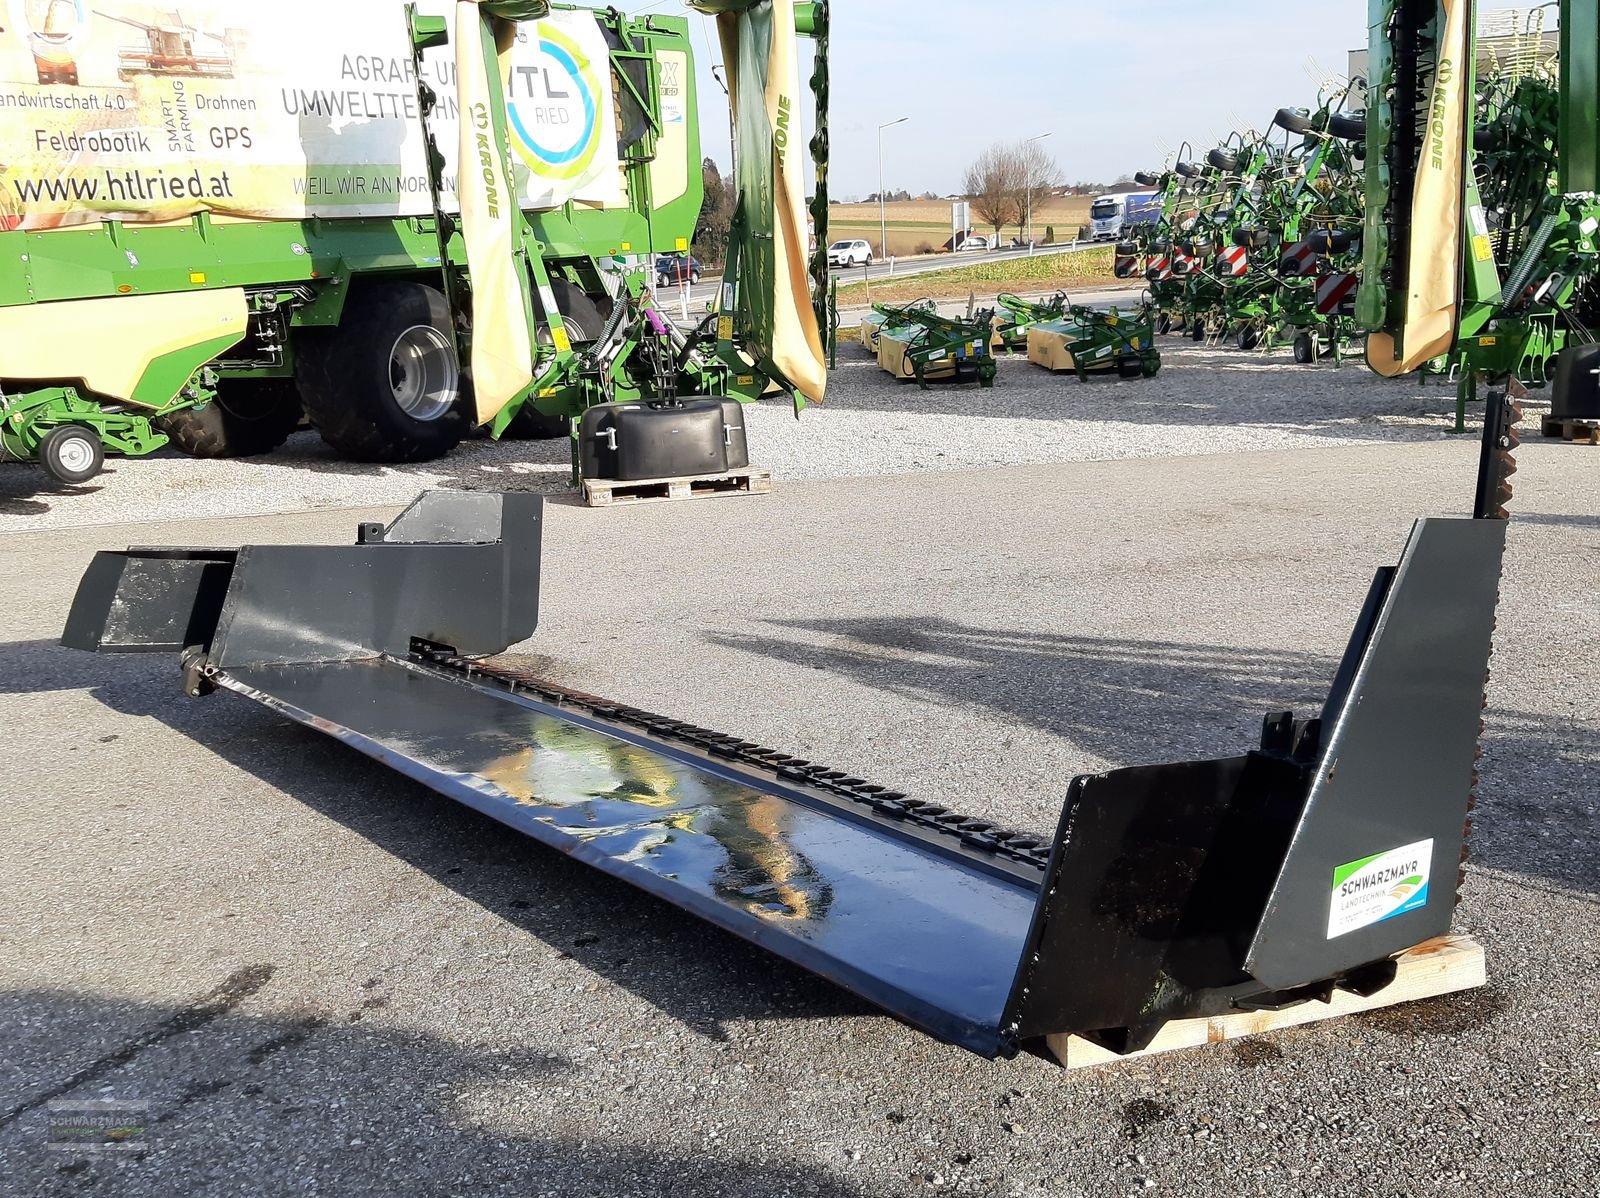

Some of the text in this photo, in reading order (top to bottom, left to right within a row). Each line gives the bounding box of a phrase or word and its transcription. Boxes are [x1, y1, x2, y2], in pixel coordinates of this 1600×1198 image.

[104, 94, 126, 111] 4.0
[195, 93, 257, 111] Drohnen
[281, 88, 459, 120] UMWELTTEHN
[535, 106, 569, 125] RIED
[160, 97, 182, 152] SMART
[173, 80, 196, 153] FARMING
[1432, 87, 1446, 171] KRONE
[35, 129, 152, 153] Feldrobotik
[209, 126, 253, 149] GPS
[14, 168, 233, 203] www.htlried.at
[293, 176, 456, 195] WEIL WIR AN MOREN
[475, 132, 499, 220] KRONE
[1341, 861, 1418, 897] SCHWARZMAYR
[1340, 889, 1387, 911] LANDTECHNIK
